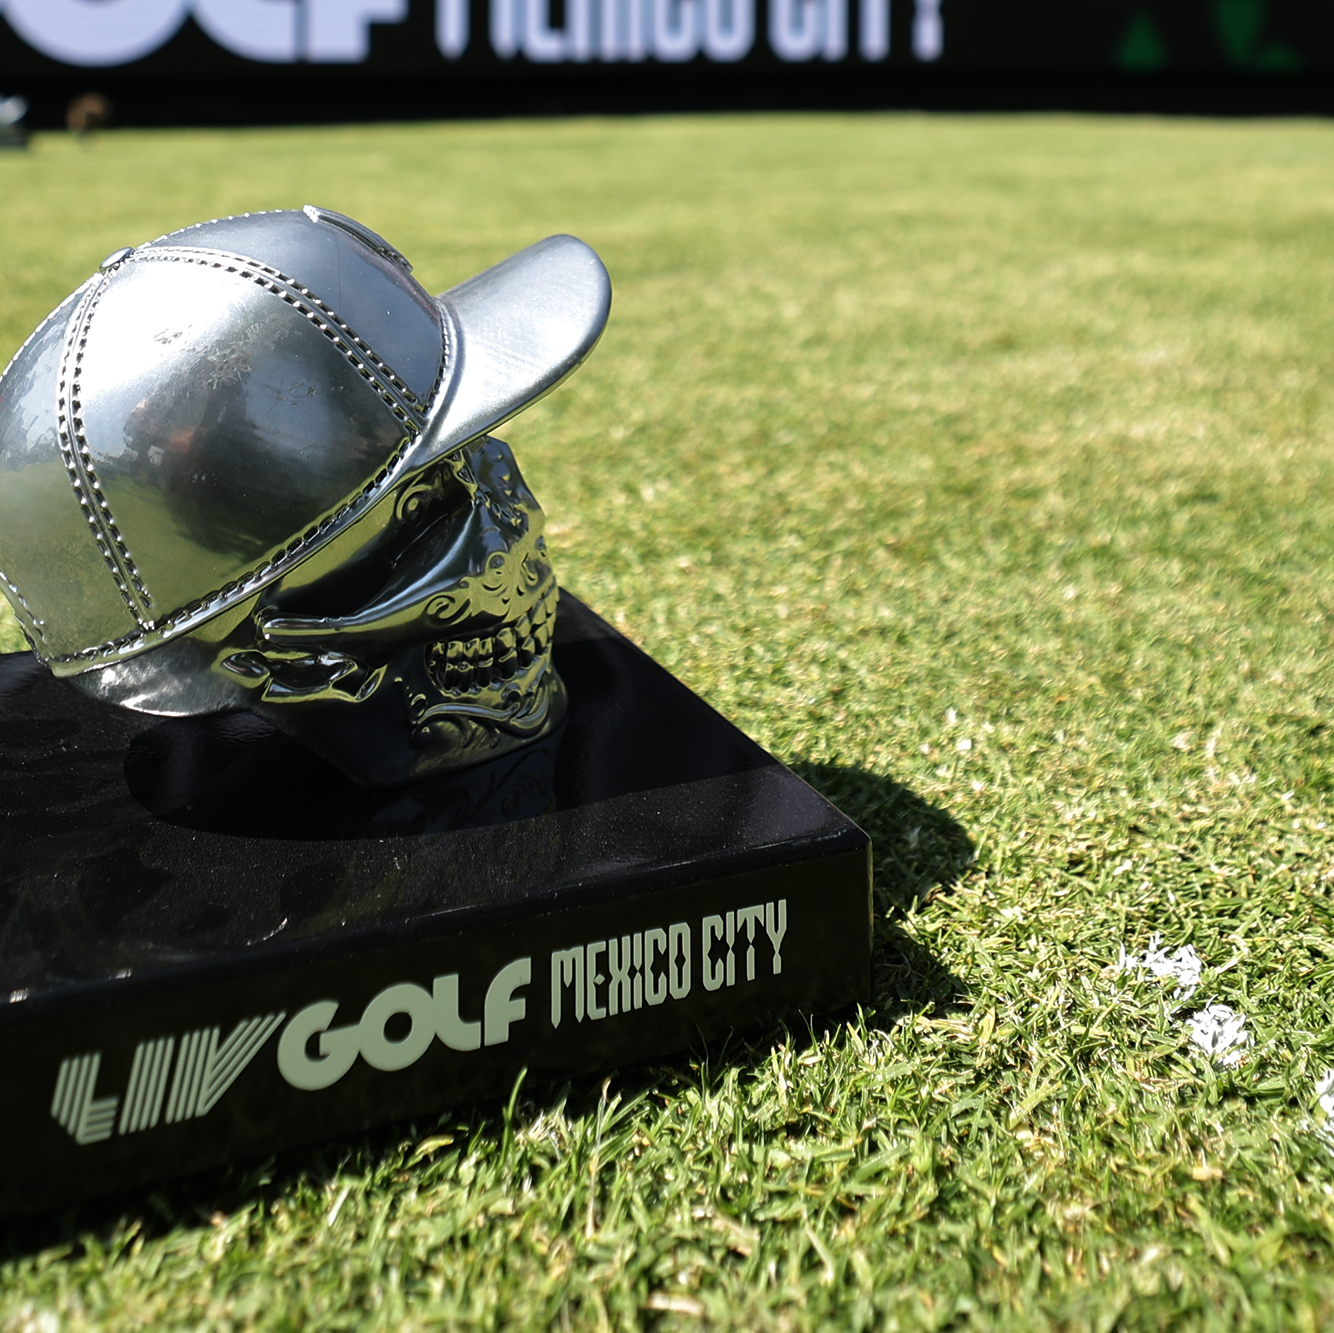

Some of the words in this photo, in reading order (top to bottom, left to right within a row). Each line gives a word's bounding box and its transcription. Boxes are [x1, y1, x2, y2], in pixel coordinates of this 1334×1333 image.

[50, 1010, 287, 1146] LIV
[277, 957, 531, 1091] GOLF
[549, 920, 691, 1030] MEXICO
[701, 898, 788, 994] CITY
